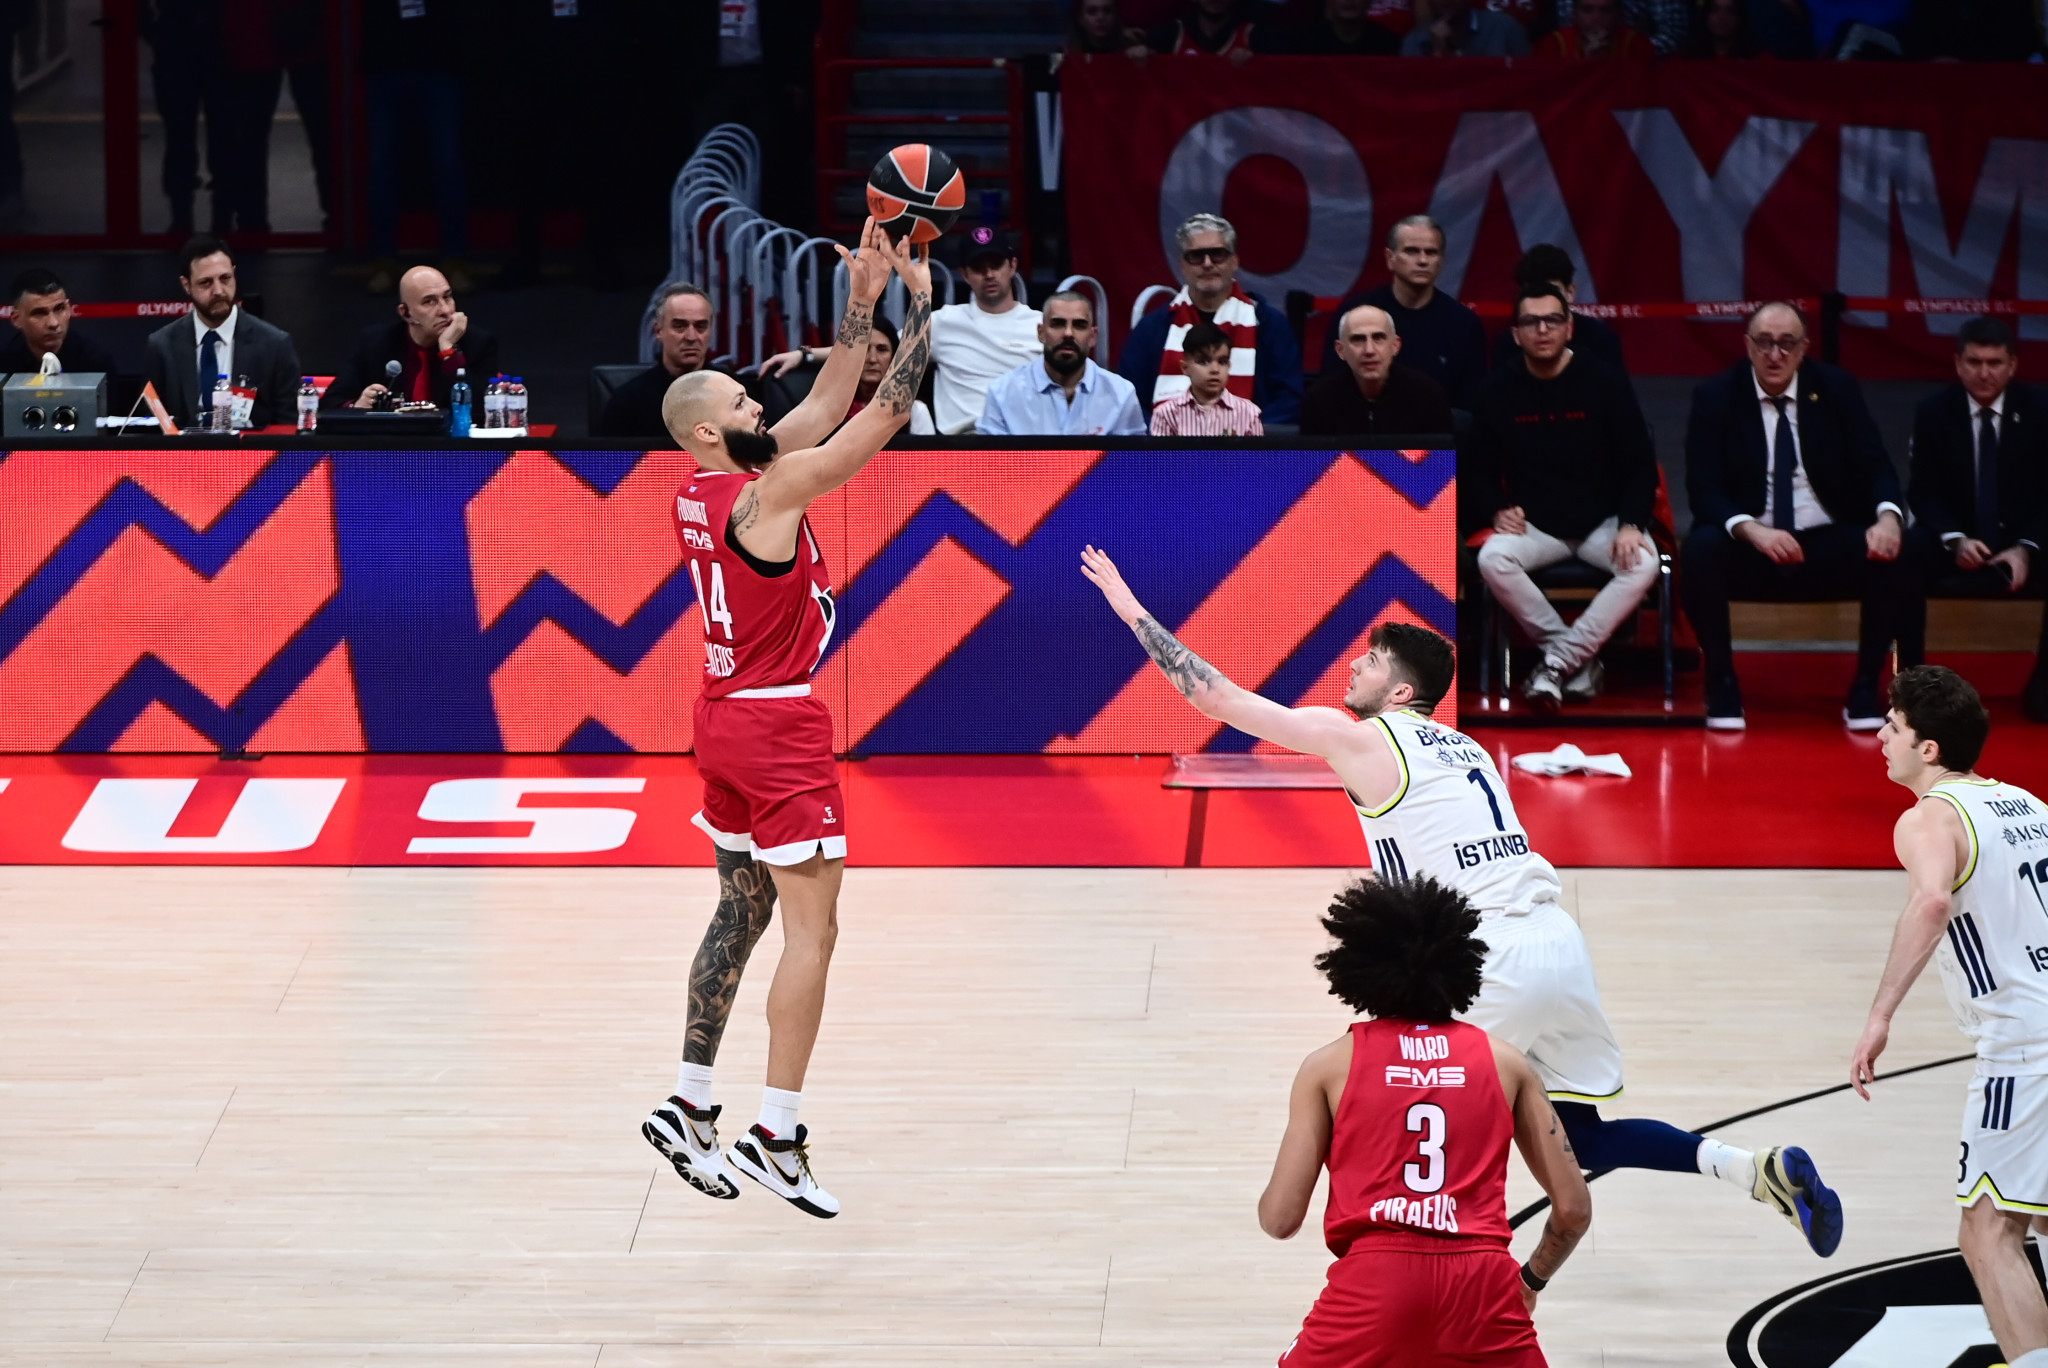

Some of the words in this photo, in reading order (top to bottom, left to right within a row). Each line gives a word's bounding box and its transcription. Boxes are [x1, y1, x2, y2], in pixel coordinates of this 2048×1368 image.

[682, 528, 715, 552] FMS
[0, 778, 647, 854] US
[1466, 768, 1506, 832] 1
[1984, 799, 2036, 818] TARIK
[1399, 1034, 1449, 1061] WARD
[1385, 1065, 1466, 1086] FMS
[1403, 1101, 1447, 1194] 3
[1369, 1194, 1459, 1233] PIRAEUS
